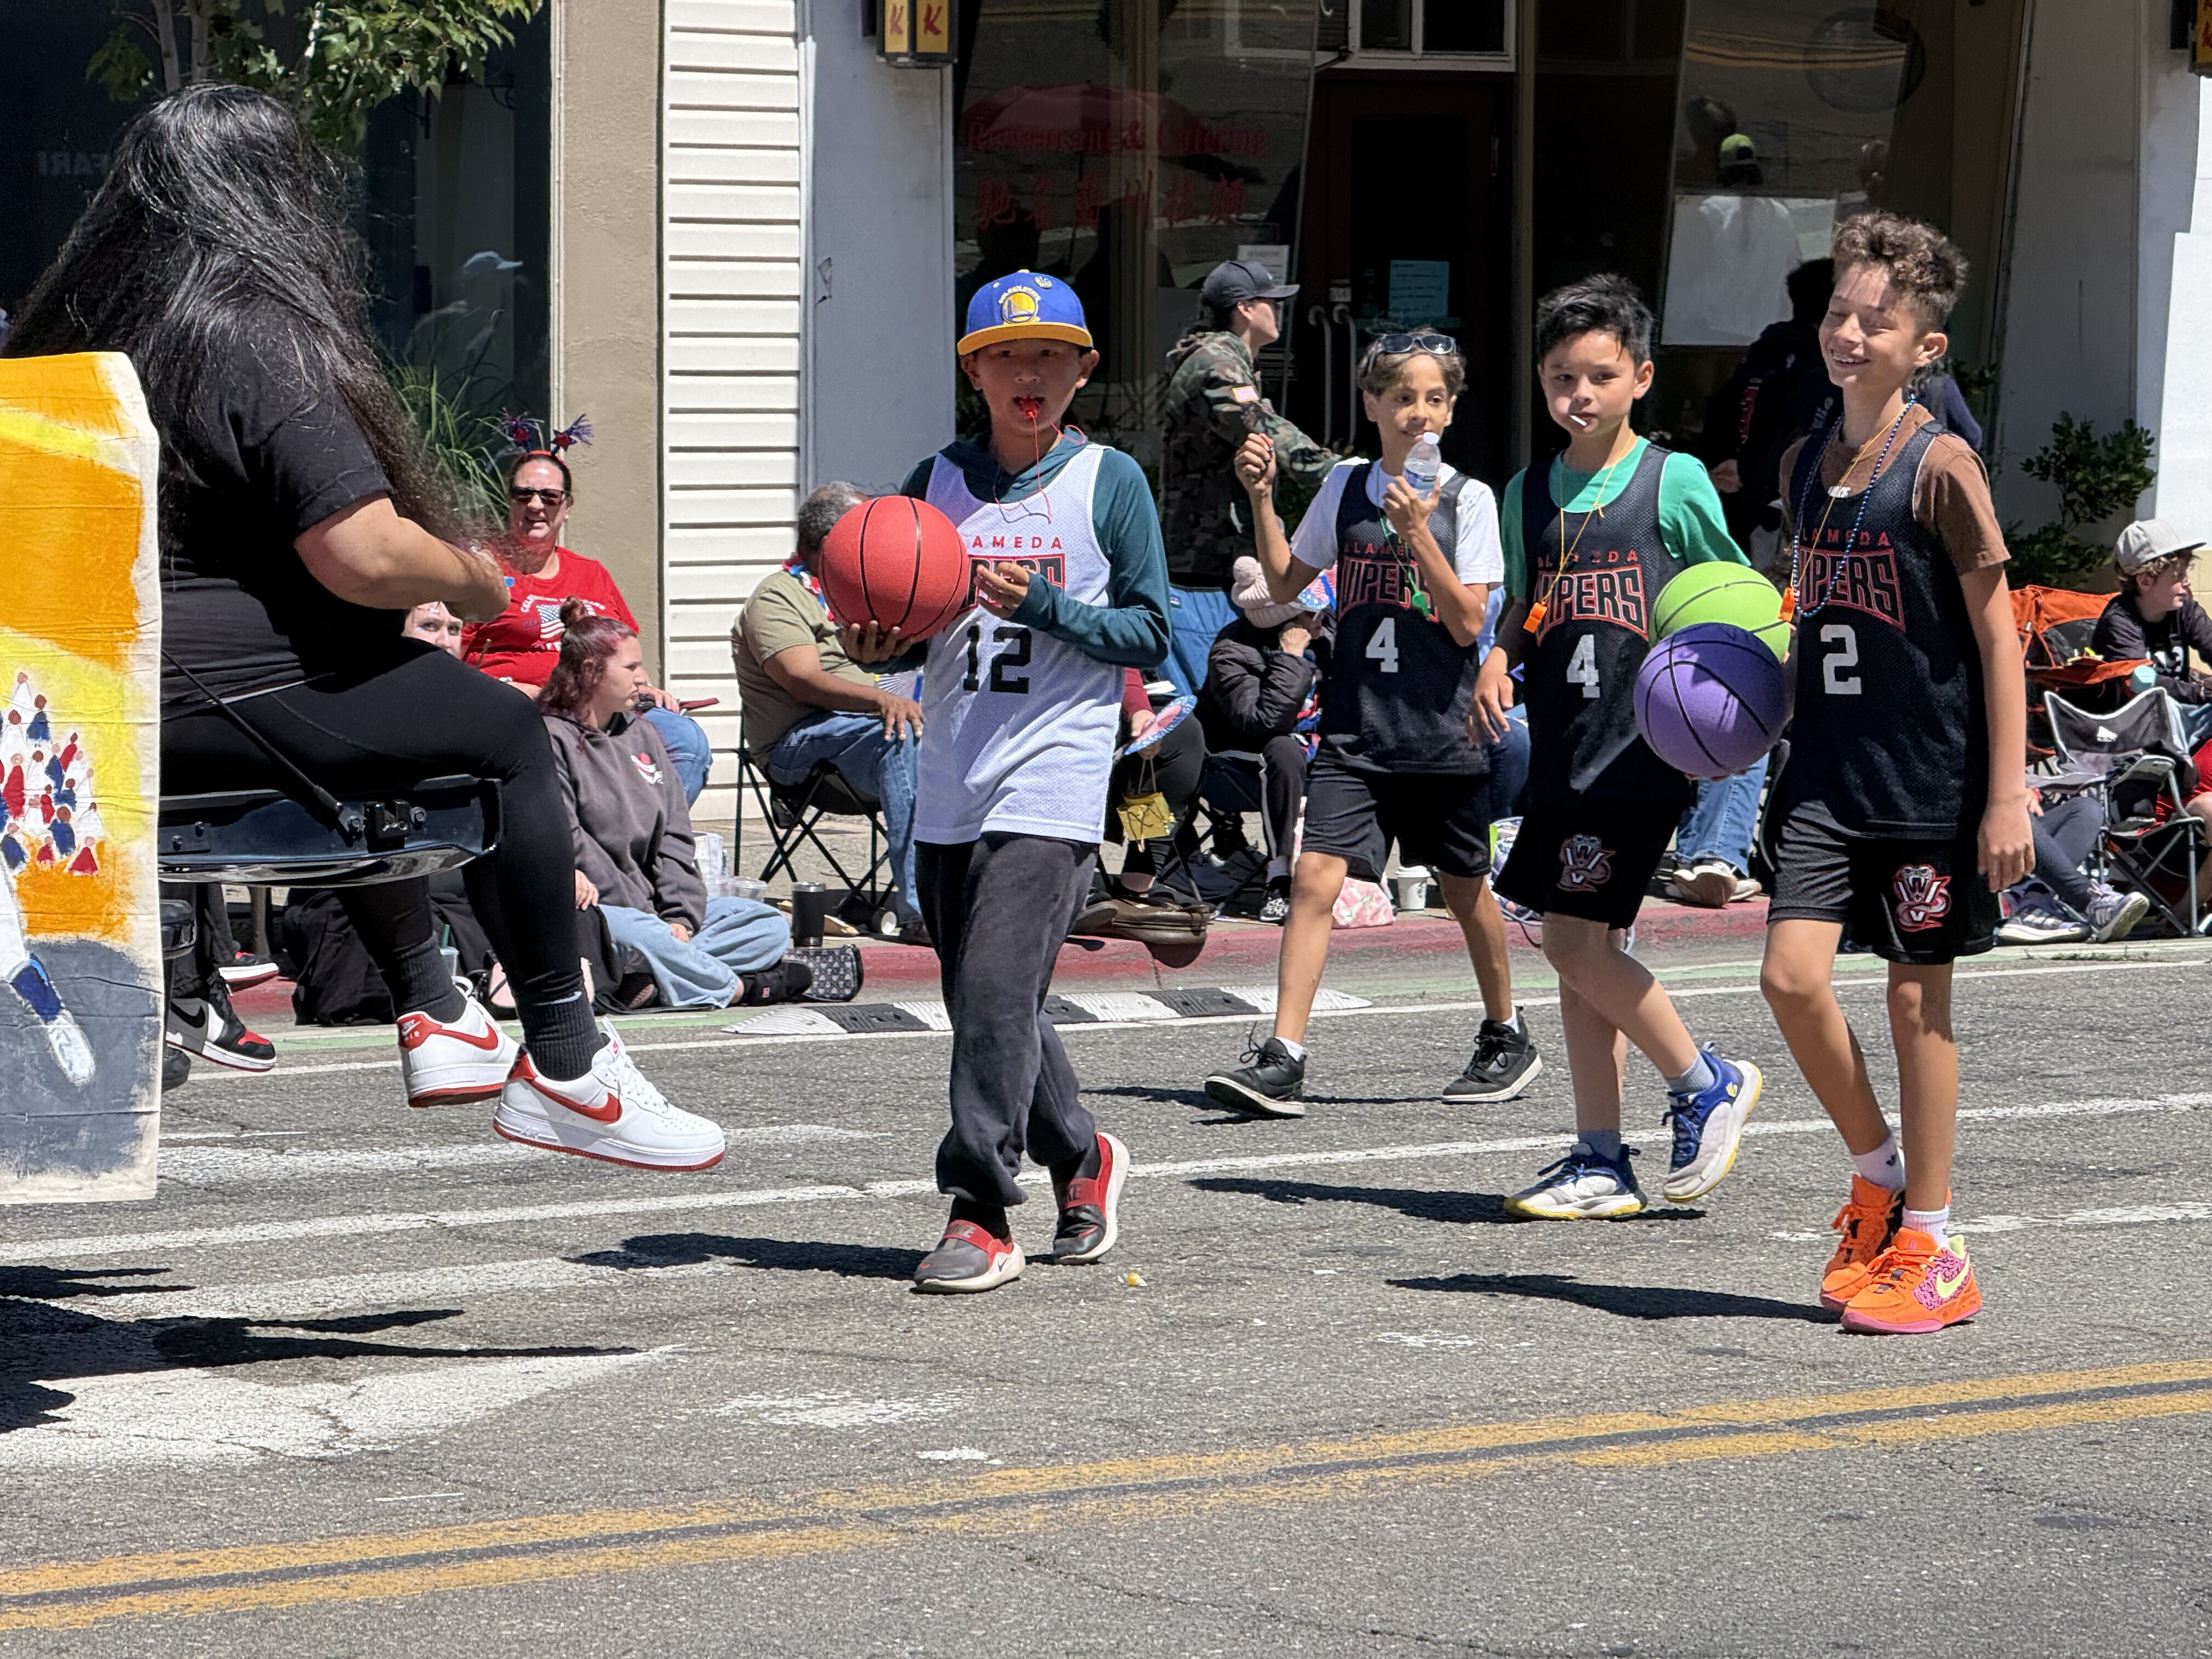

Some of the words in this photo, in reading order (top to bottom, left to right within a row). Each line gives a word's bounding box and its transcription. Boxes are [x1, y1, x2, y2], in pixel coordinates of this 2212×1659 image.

[890, 3, 904, 35] K
[923, 2, 942, 36] K
[967, 121, 1110, 151] Restaurant
[1122, 120, 1142, 150] &
[1158, 120, 1268, 158] Catering
[972, 535, 1063, 549] AMEDA
[963, 625, 1032, 694] 12
[1365, 617, 1399, 673] 4
[1566, 634, 1601, 698] 4
[1820, 624, 1862, 695] 2
